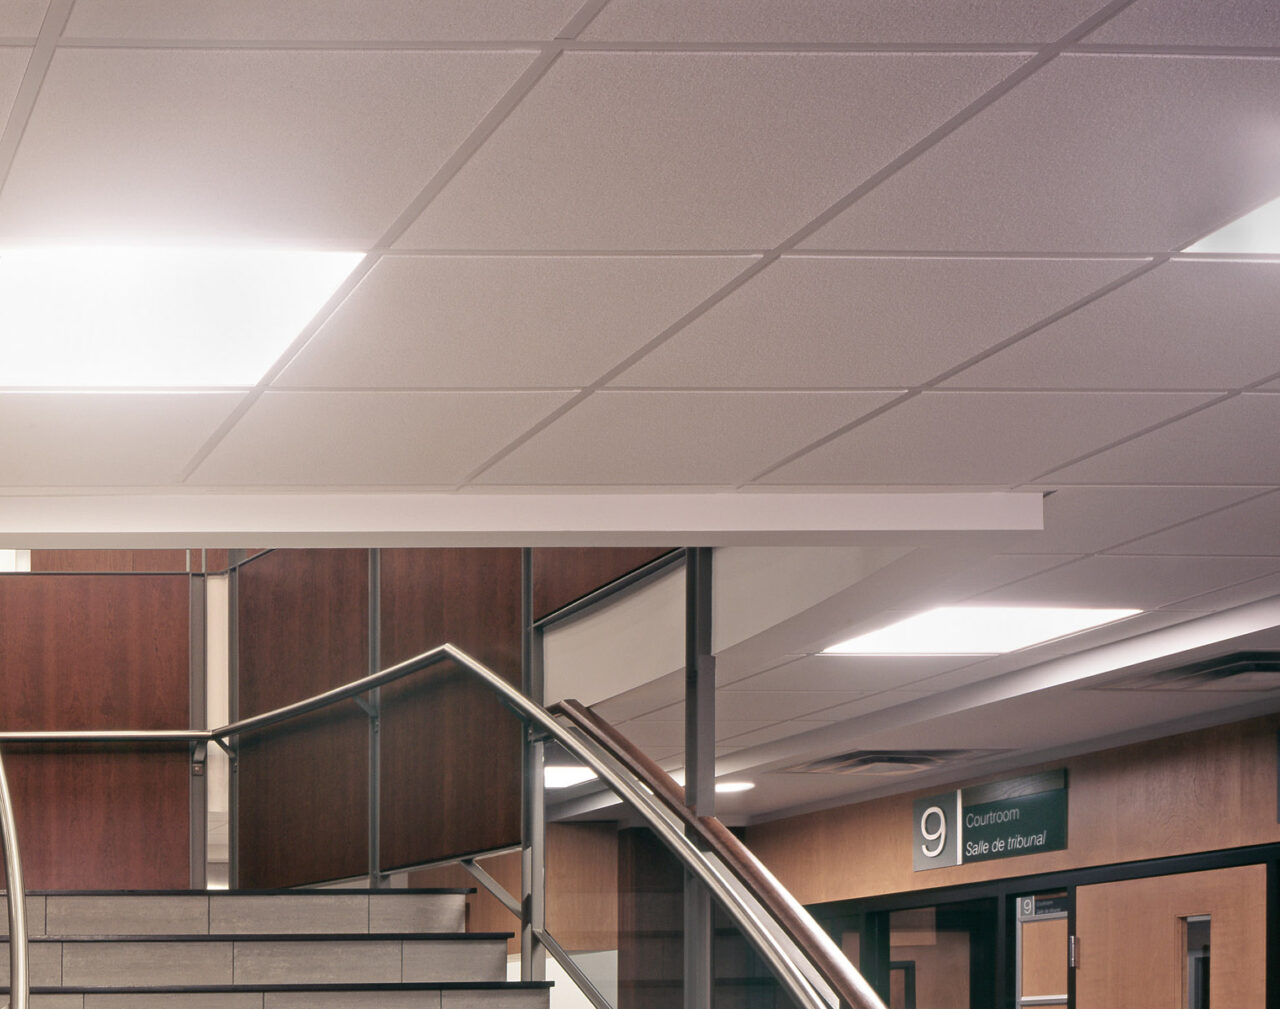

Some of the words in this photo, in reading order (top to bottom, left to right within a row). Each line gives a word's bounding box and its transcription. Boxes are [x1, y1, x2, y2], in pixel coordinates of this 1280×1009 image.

[966, 808, 1020, 828] Courtroom
[921, 806, 947, 858] 9
[966, 841, 989, 856] Salle
[992, 838, 1005, 852] de
[1007, 830, 1047, 850] tribunal
[1023, 899, 1032, 914] 9
